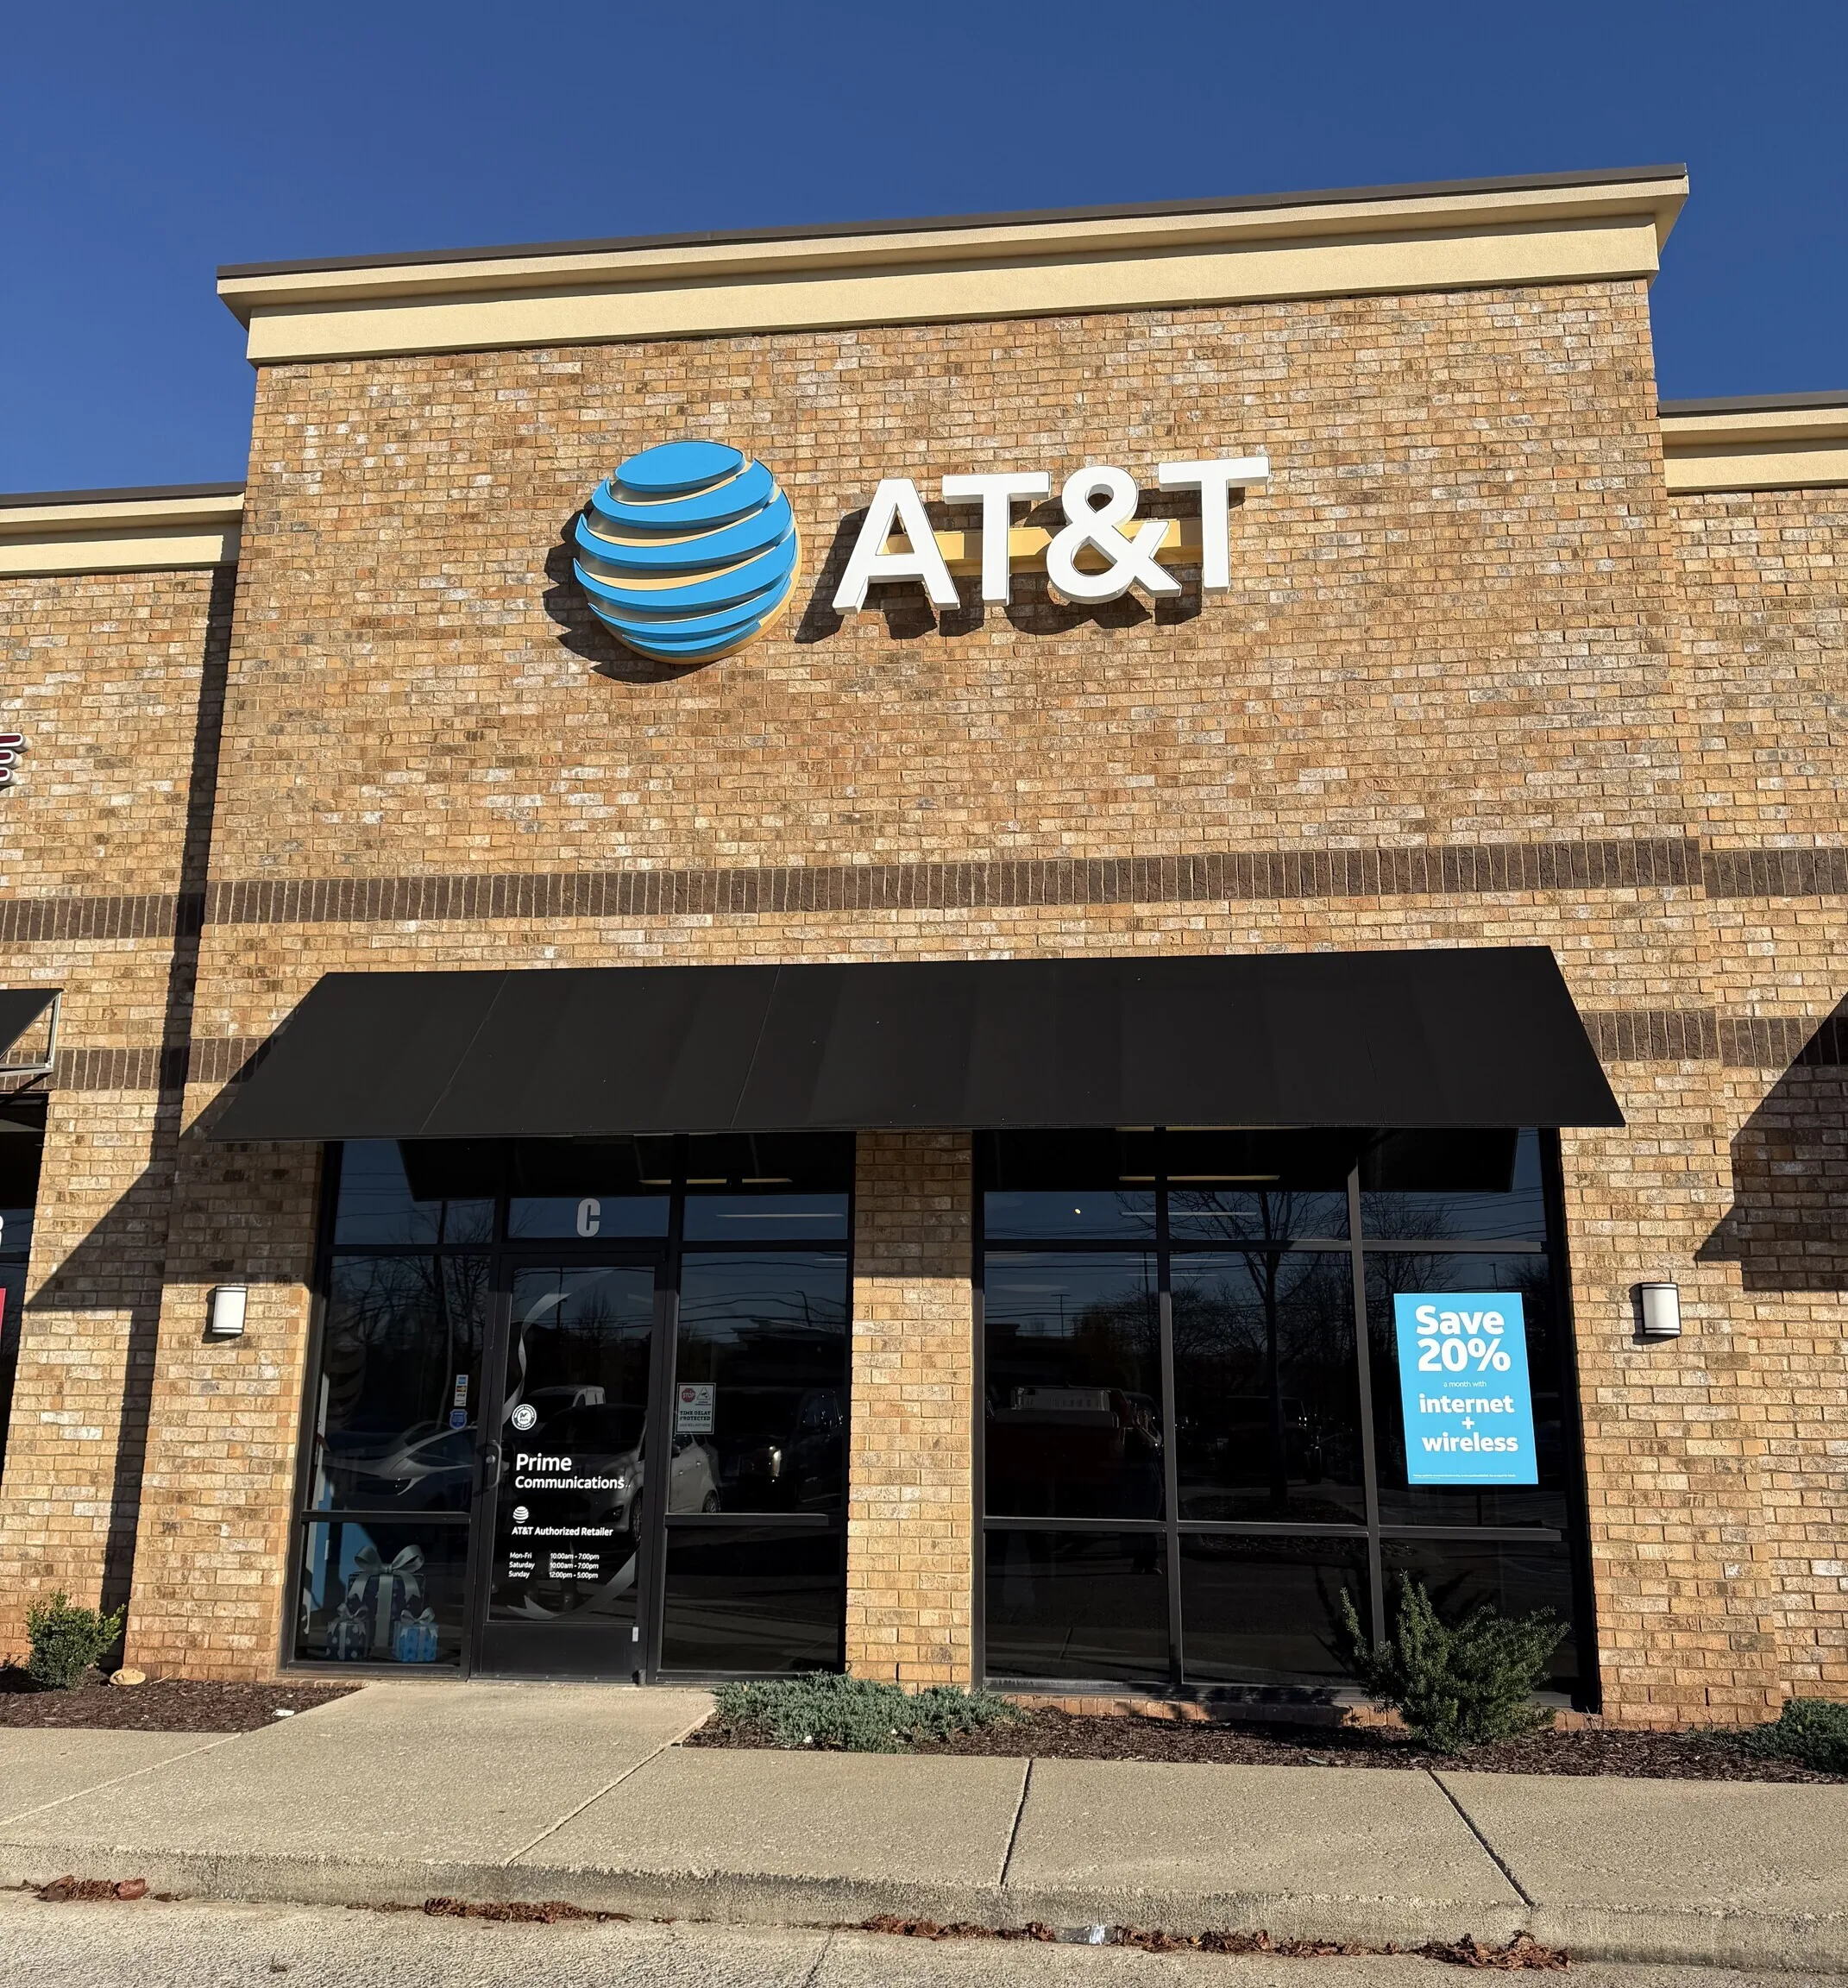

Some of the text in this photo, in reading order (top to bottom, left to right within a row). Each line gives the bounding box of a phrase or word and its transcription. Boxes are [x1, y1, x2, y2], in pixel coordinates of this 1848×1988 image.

[831, 455, 1271, 616] AT&T
[577, 1198, 600, 1237] C
[1416, 1305, 1504, 1335] Save
[1417, 1338, 1511, 1371] 20%
[1420, 1393, 1514, 1412] internet
[1462, 1417, 1474, 1429] +
[1422, 1432, 1518, 1451] wireless
[517, 1453, 571, 1471] Prime
[515, 1475, 625, 1489] Communications
[512, 1526, 613, 1536] AT&T Authorized Retailer
[509, 1570, 530, 1579] Sunday
[550, 1571, 573, 1580] 12:00pm
